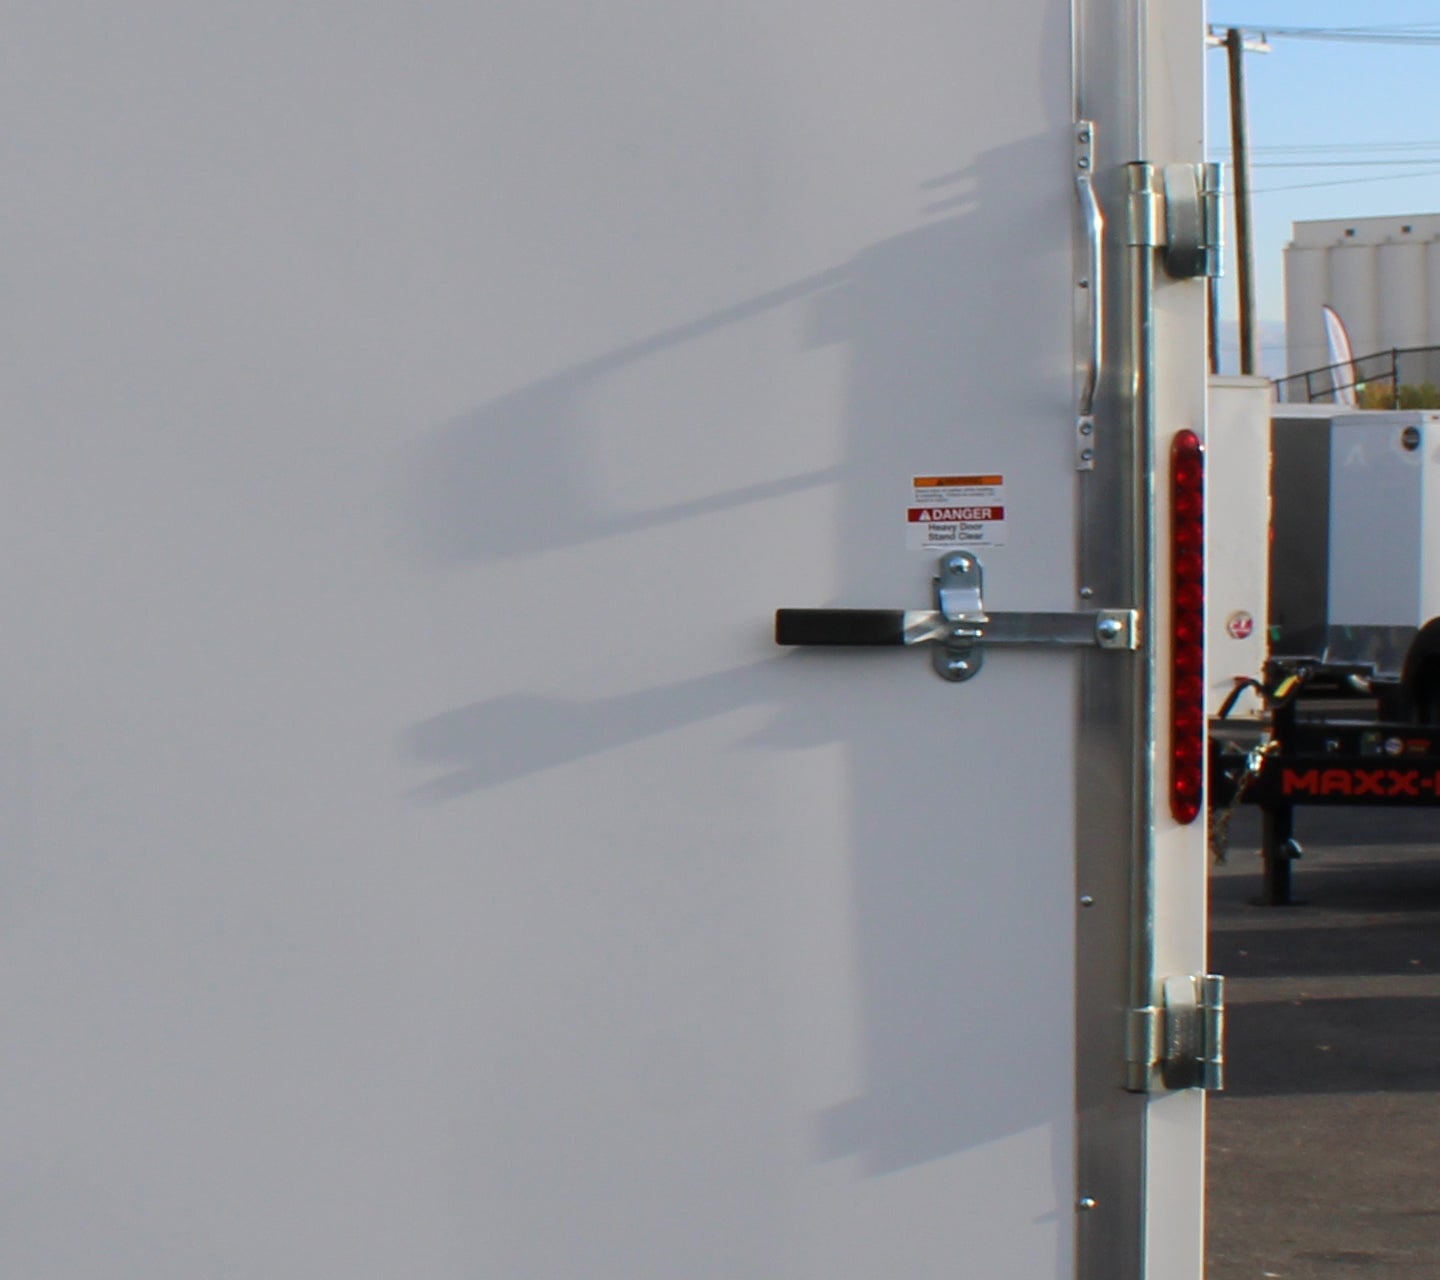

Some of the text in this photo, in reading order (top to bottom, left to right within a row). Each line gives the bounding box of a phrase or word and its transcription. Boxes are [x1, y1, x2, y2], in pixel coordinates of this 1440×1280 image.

[932, 508, 992, 520] DANGER
[928, 522, 983, 532] Heavy Door
[928, 531, 983, 541] Stand Clear
